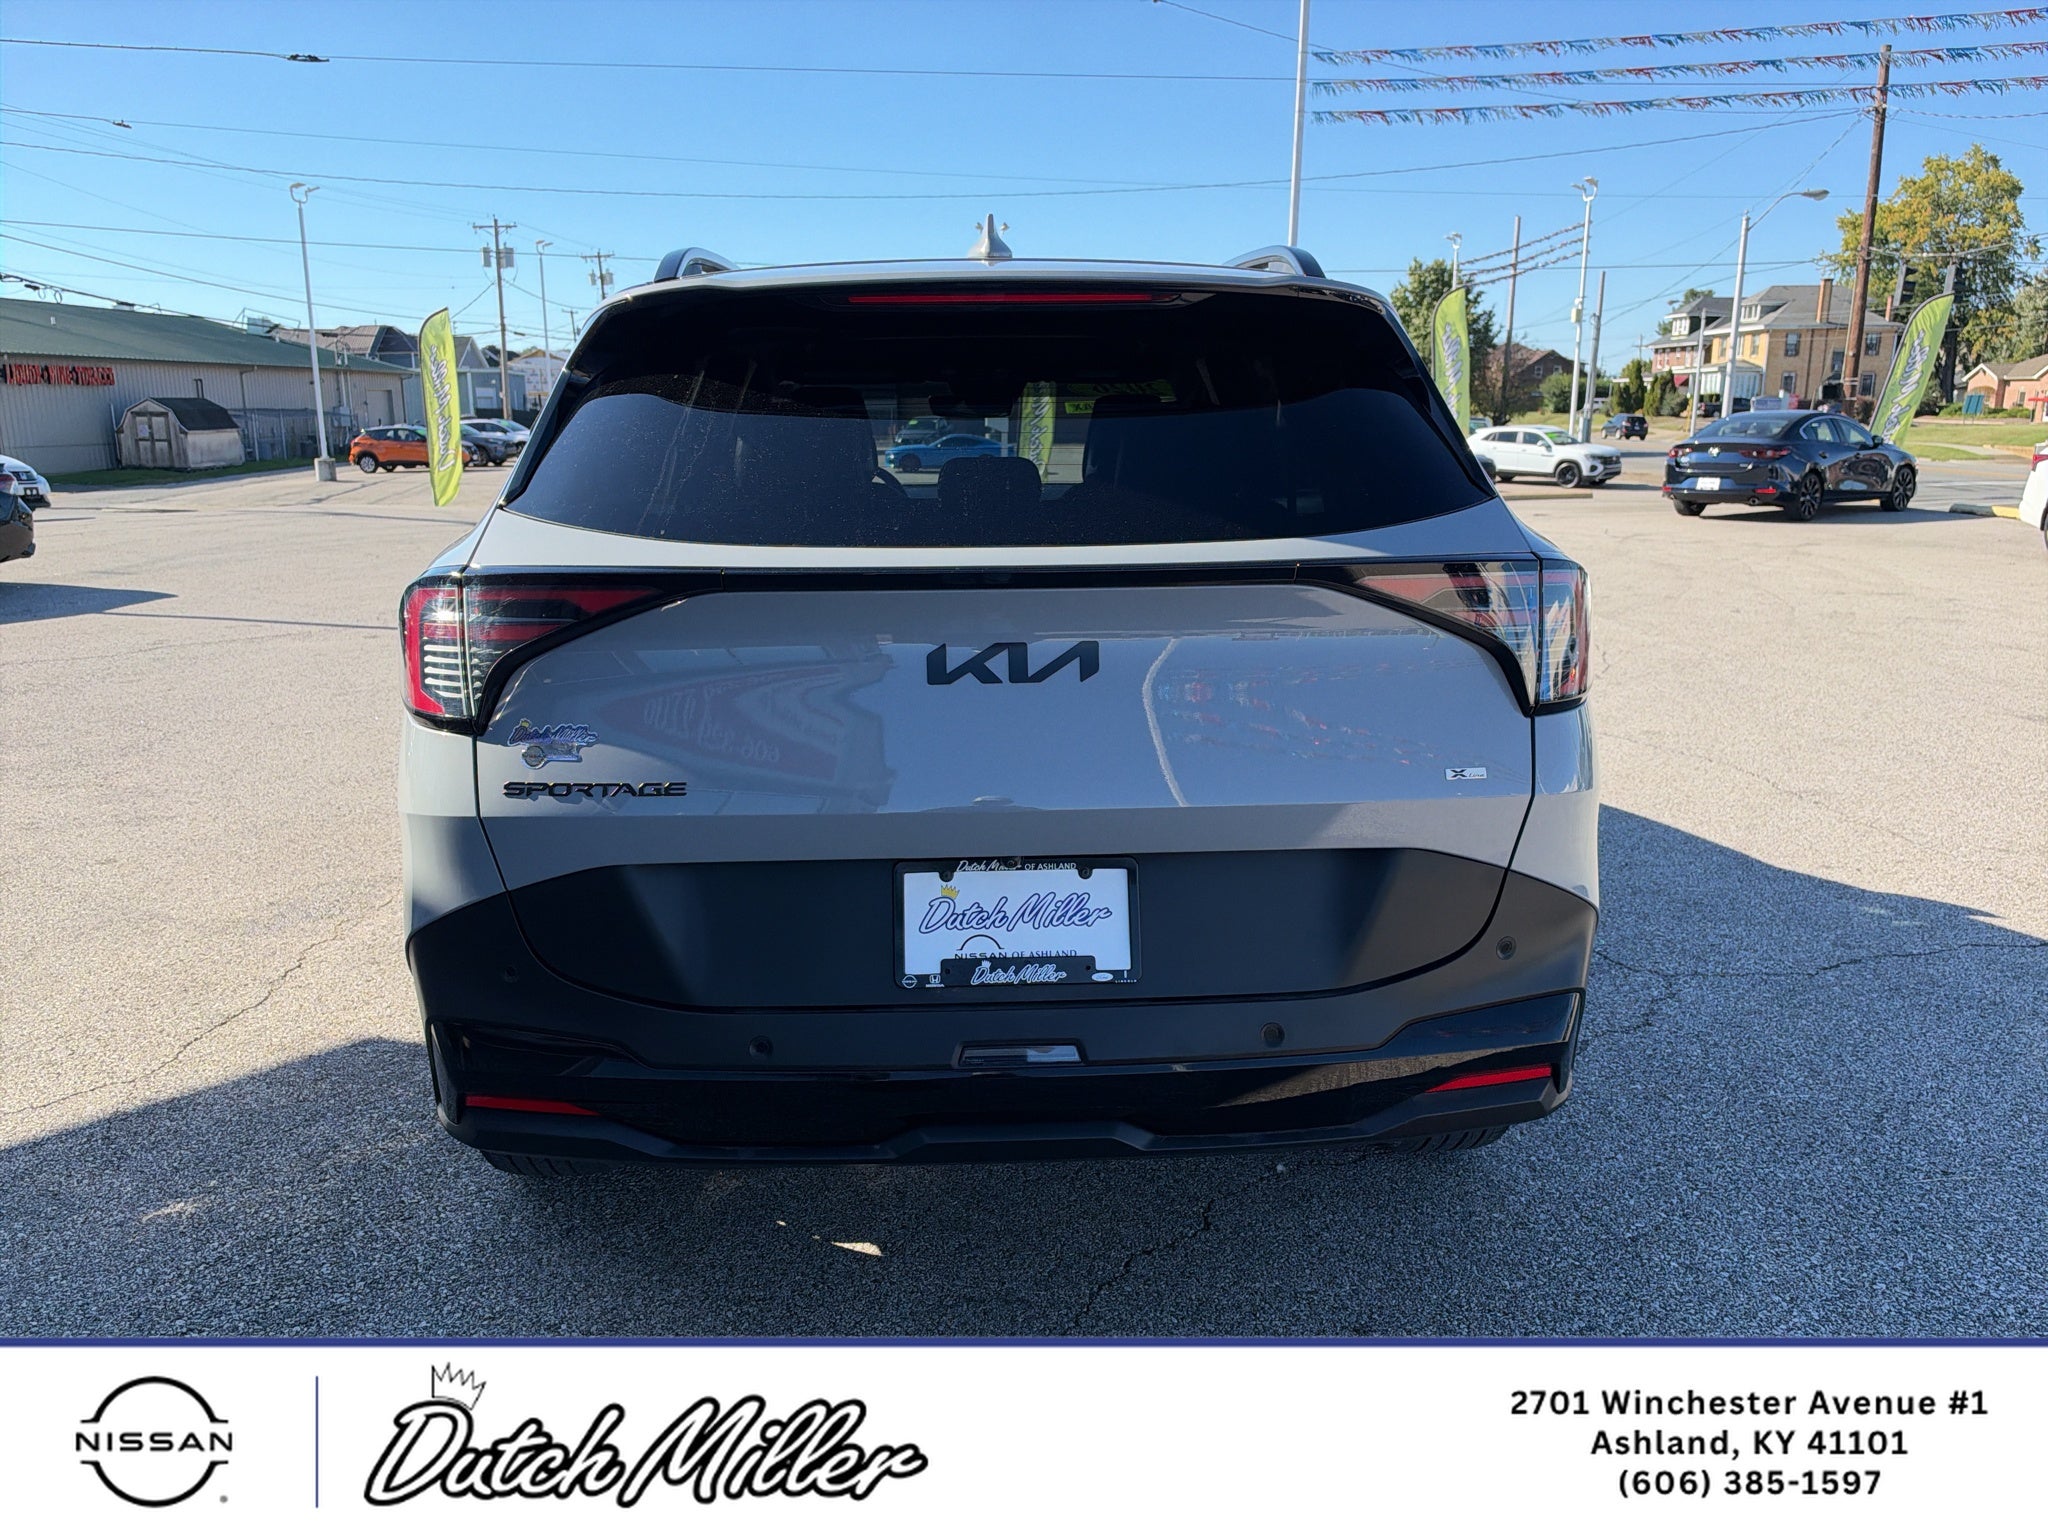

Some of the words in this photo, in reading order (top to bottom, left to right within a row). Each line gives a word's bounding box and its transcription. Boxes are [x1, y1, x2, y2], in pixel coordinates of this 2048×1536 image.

[927, 640, 1100, 685] KIA
[503, 781, 687, 799] SPORTAGE
[956, 860, 987, 872] Dutch
[1024, 863, 1036, 871] OF
[1037, 862, 1077, 871] ASHLAND
[919, 896, 1010, 935] Dutch
[1006, 892, 1114, 932] Miller
[970, 965, 1017, 986] Dutch
[1013, 963, 1068, 984] Miller
